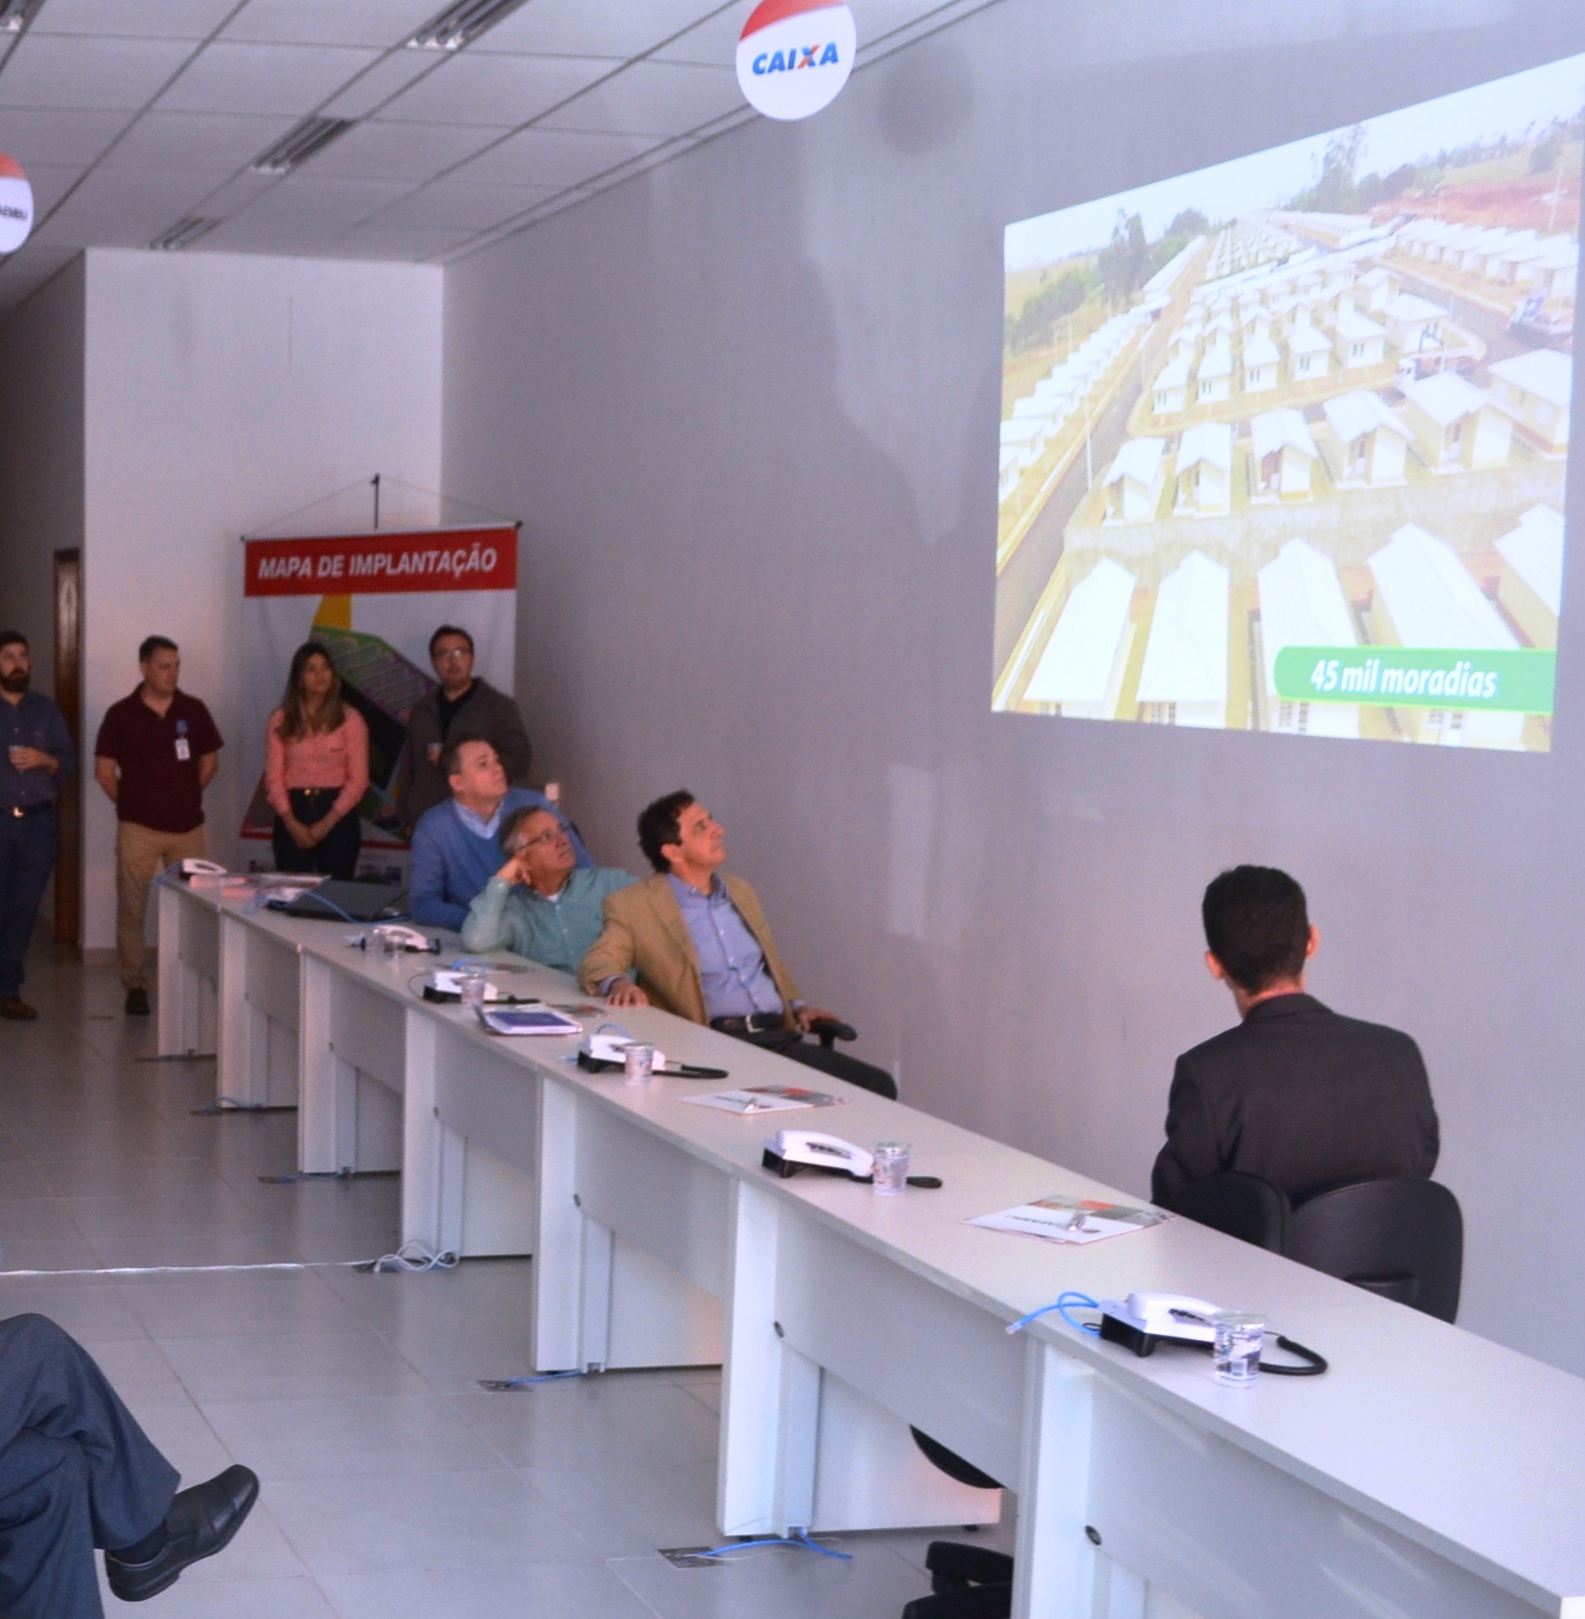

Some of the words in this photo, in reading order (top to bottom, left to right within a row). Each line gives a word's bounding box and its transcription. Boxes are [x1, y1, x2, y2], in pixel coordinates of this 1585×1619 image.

[752, 41, 839, 75] CAIXA
[258, 556, 312, 580] MAPA
[317, 554, 345, 578] DE
[349, 543, 498, 579] IMPLANTAÇÃO
[1310, 659, 1339, 692] 45
[1341, 658, 1380, 693] mil
[1380, 660, 1498, 698] moradias
